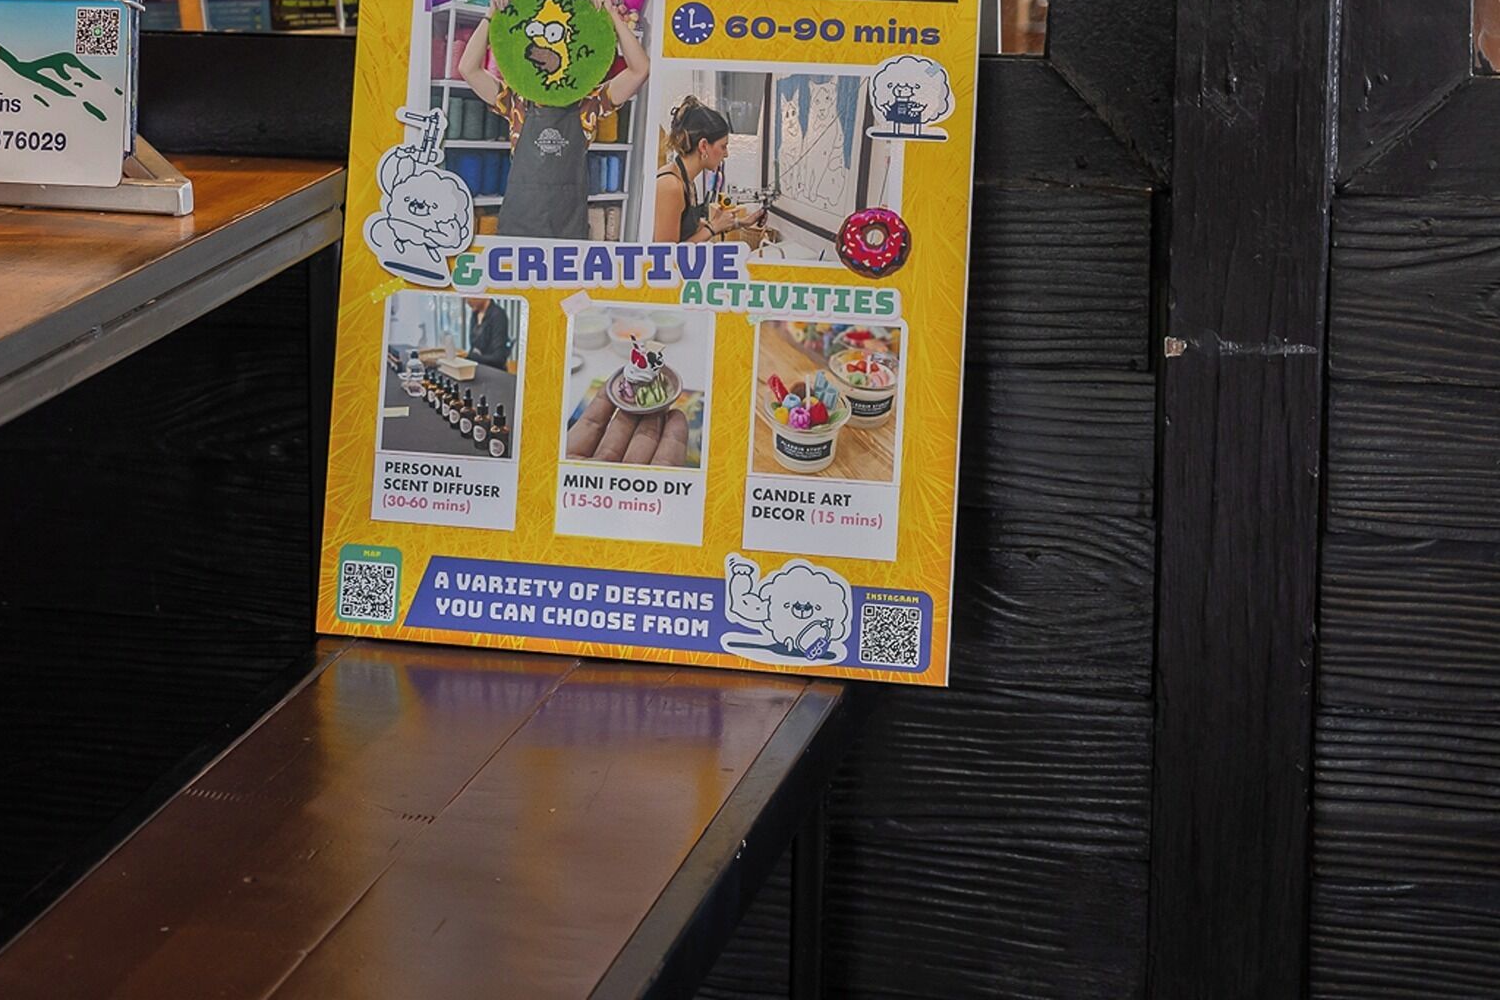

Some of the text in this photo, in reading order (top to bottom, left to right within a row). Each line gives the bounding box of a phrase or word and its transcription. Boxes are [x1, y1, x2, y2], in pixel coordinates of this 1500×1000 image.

[724, 16, 940, 45] 60-90 mins
[452, 245, 740, 286] & CREATIVE
[680, 279, 896, 316] ACTIVITIES
[385, 462, 462, 478] PERSONAL
[384, 478, 500, 498] SCENT DIFFUSER
[563, 474, 693, 496] MINI FOOD DIY
[383, 496, 471, 514] (30-60 mins)
[562, 493, 662, 515] (15-30 mins)
[752, 488, 852, 507] CANDLE ART
[751, 506, 884, 530] DECOR (15 mins)
[362, 550, 382, 558] MAP
[434, 572, 715, 612] A VARIETY OF DESIGNS
[866, 593, 919, 603] INSTAGRAM
[435, 598, 710, 637] YOU CAN CHOOSE FROM
